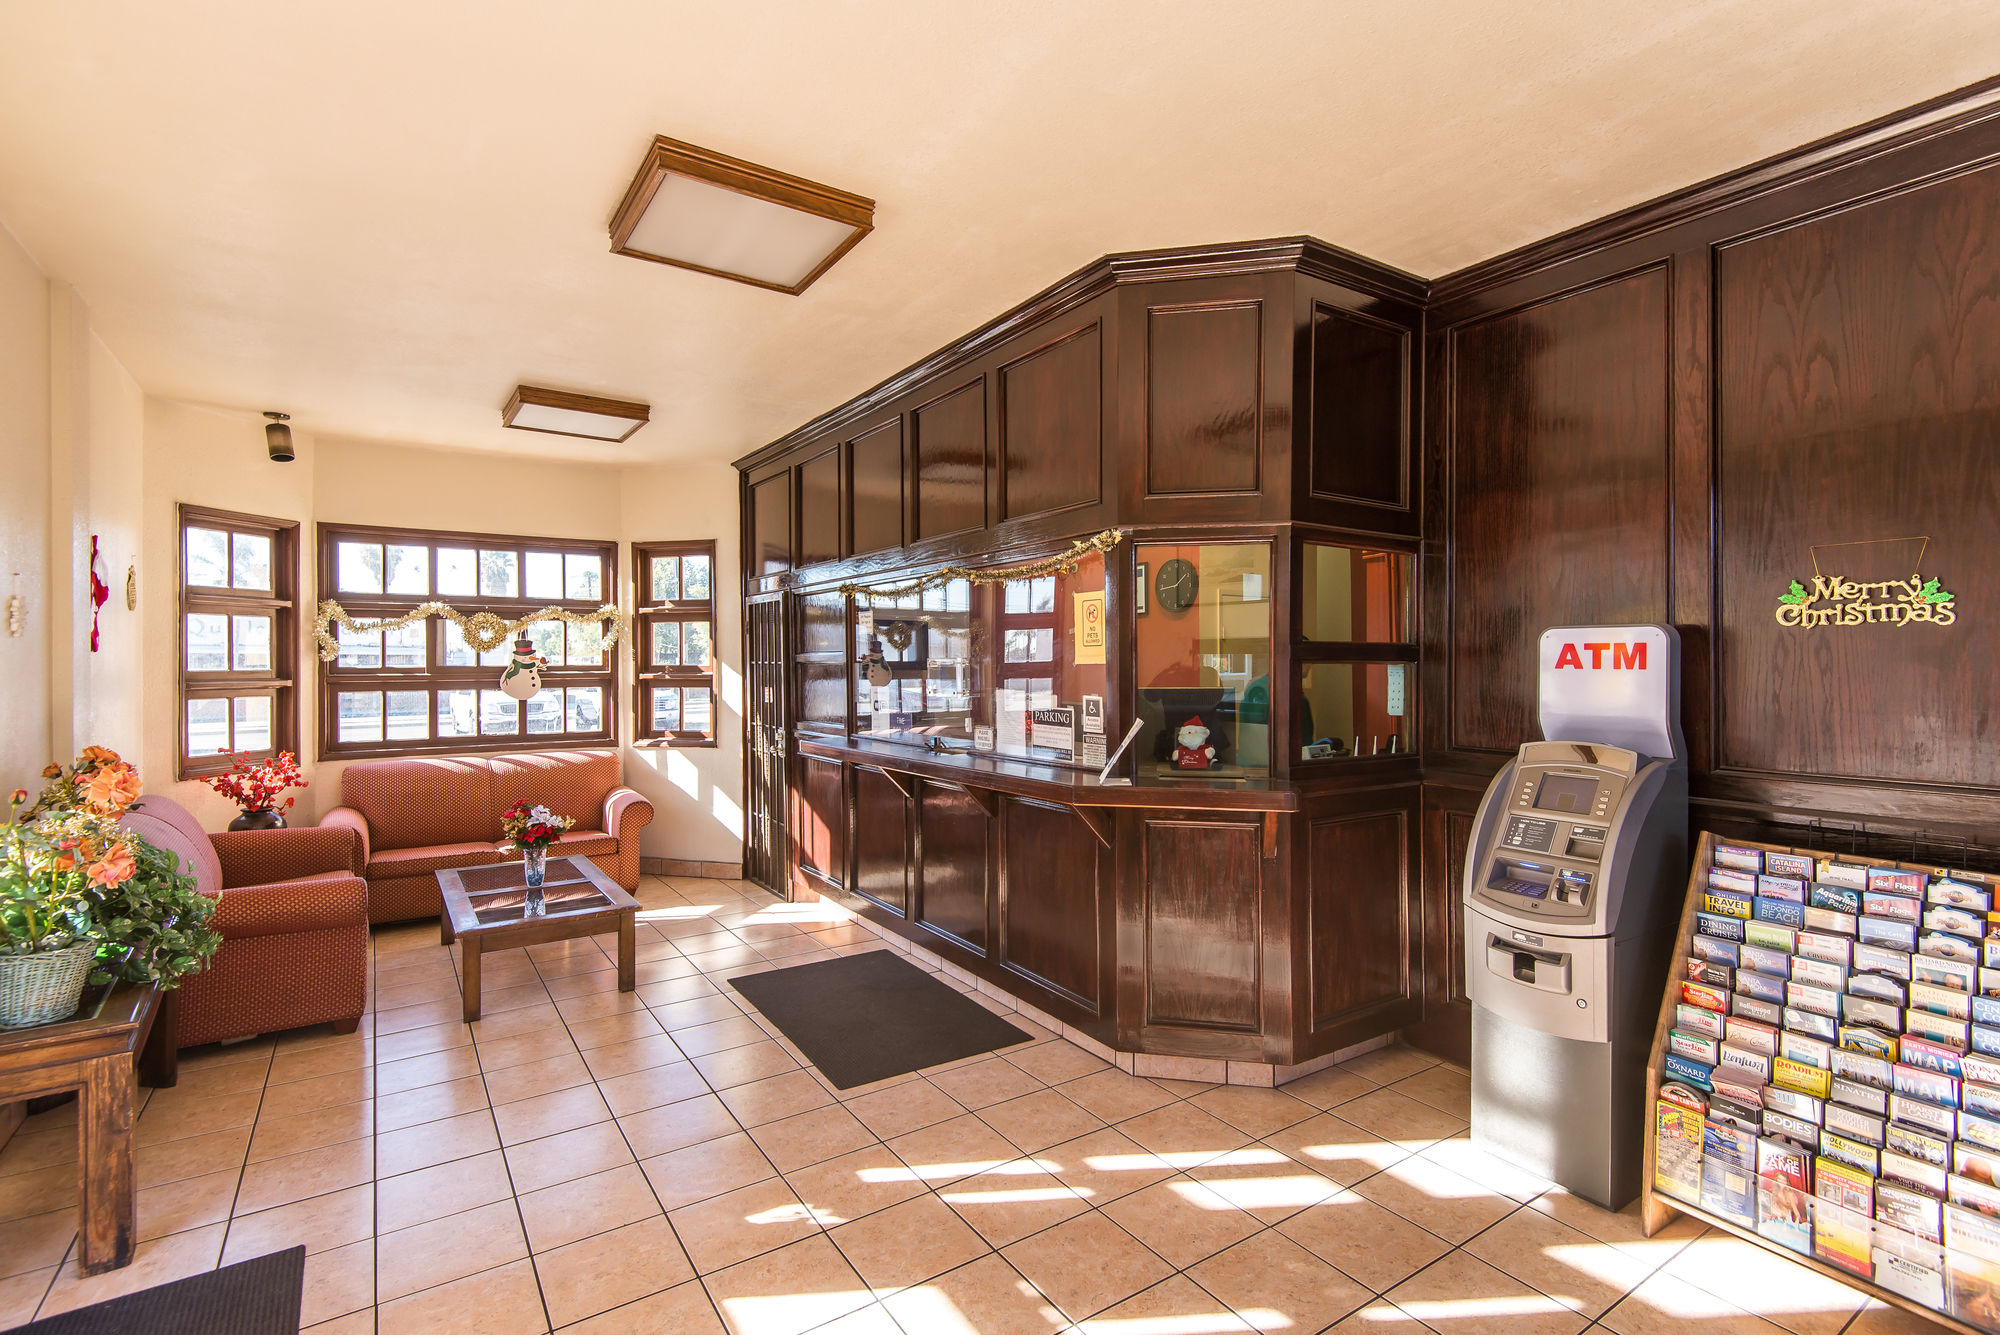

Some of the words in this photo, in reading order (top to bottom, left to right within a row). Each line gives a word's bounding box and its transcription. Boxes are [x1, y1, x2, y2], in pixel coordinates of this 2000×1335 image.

[1808, 575, 1922, 603] Merry
[1776, 602, 1956, 629] Christmas
[1555, 642, 1648, 670] ATM
[1035, 710, 1070, 724] PARKING
[1770, 859, 1806, 868] CATALINA
[1775, 865, 1803, 874] ISLAND
[1876, 880, 1889, 888] Six
[1895, 882, 1918, 892] Flags
[1708, 896, 1746, 910] TRAVEL
[1716, 892, 1740, 900] ONLINE
[1816, 888, 1858, 908] Aquarium
[1709, 904, 1736, 915] INFO
[1762, 904, 1800, 915] REDONDO
[1828, 898, 1856, 914] Pacific
[1870, 904, 1884, 912] Six
[1890, 906, 1912, 916] Flags
[1761, 910, 1800, 924] BEACH
[1700, 920, 1737, 932] DINING
[1700, 927, 1738, 940] CRUISES
[1888, 930, 1906, 940] Getty
[1807, 952, 1839, 962] CityPASS
[1946, 962, 1968, 970] NIXON
[1800, 976, 1832, 988] CityPASS
[1739, 1002, 1771, 1014] Hollywood
[1796, 1002, 1828, 1014] CityPASS
[1846, 1034, 1868, 1043] STUDIO
[1870, 1038, 1887, 1048] TOUR
[1904, 1042, 1926, 1050] SANTA
[1928, 1047, 1954, 1058] MONICA
[1904, 1050, 1956, 1072] MAP
[1667, 1060, 1706, 1079] OXNARD
[1776, 1060, 1824, 1078] ROADIUM
[1834, 1082, 1881, 1102] SINATRA
[1897, 1076, 1949, 1100] MAP
[1764, 1112, 1812, 1135] BODIES
[1824, 1134, 1872, 1158] HOLLYWOOD
[1888, 1128, 1904, 1138] TOUR
[1906, 1134, 1943, 1150] HOLLYWOOD
[1768, 1158, 1800, 1176] AME
[1786, 1158, 1800, 1168] OF
[1820, 1170, 1846, 1183] CELEBRITY
[1836, 1180, 1850, 1188] TOUR
[1900, 1259, 1929, 1276] CERTIFIED
